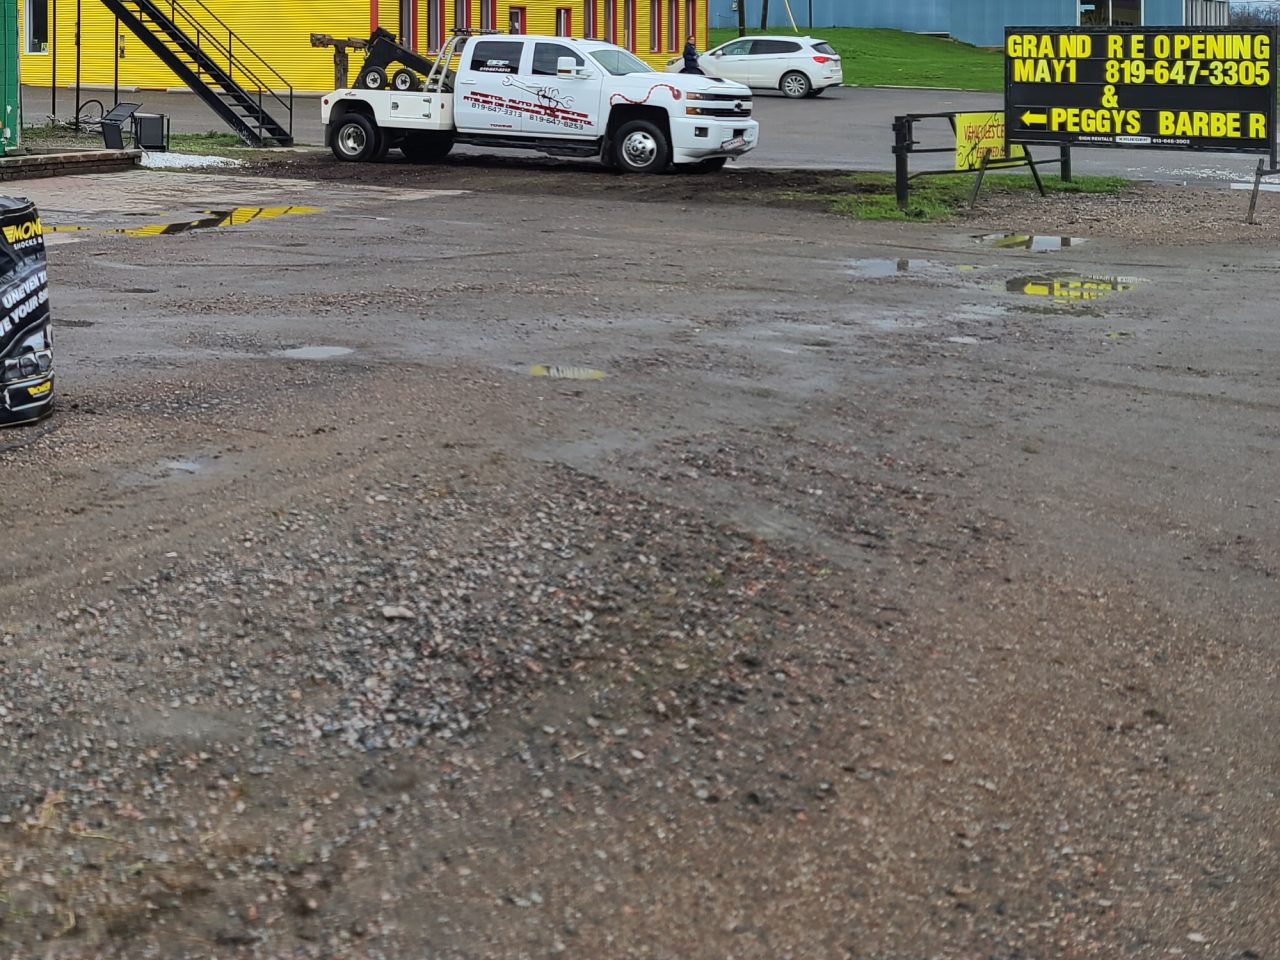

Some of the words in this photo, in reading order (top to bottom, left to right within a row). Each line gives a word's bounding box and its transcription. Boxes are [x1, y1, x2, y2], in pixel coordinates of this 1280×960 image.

[1007, 34, 1092, 58] GRAND
[1105, 60, 1270, 85] 819-647-3305
[508, 97, 532, 107] AUTO
[1101, 85, 1119, 108] &
[471, 102, 523, 118] 819-647-3313
[1051, 108, 1141, 134] PEGGYS
[13, 239, 37, 251] SHOCKS
[1, 272, 40, 309] UNEVEN
[11, 296, 40, 326] YOUR
